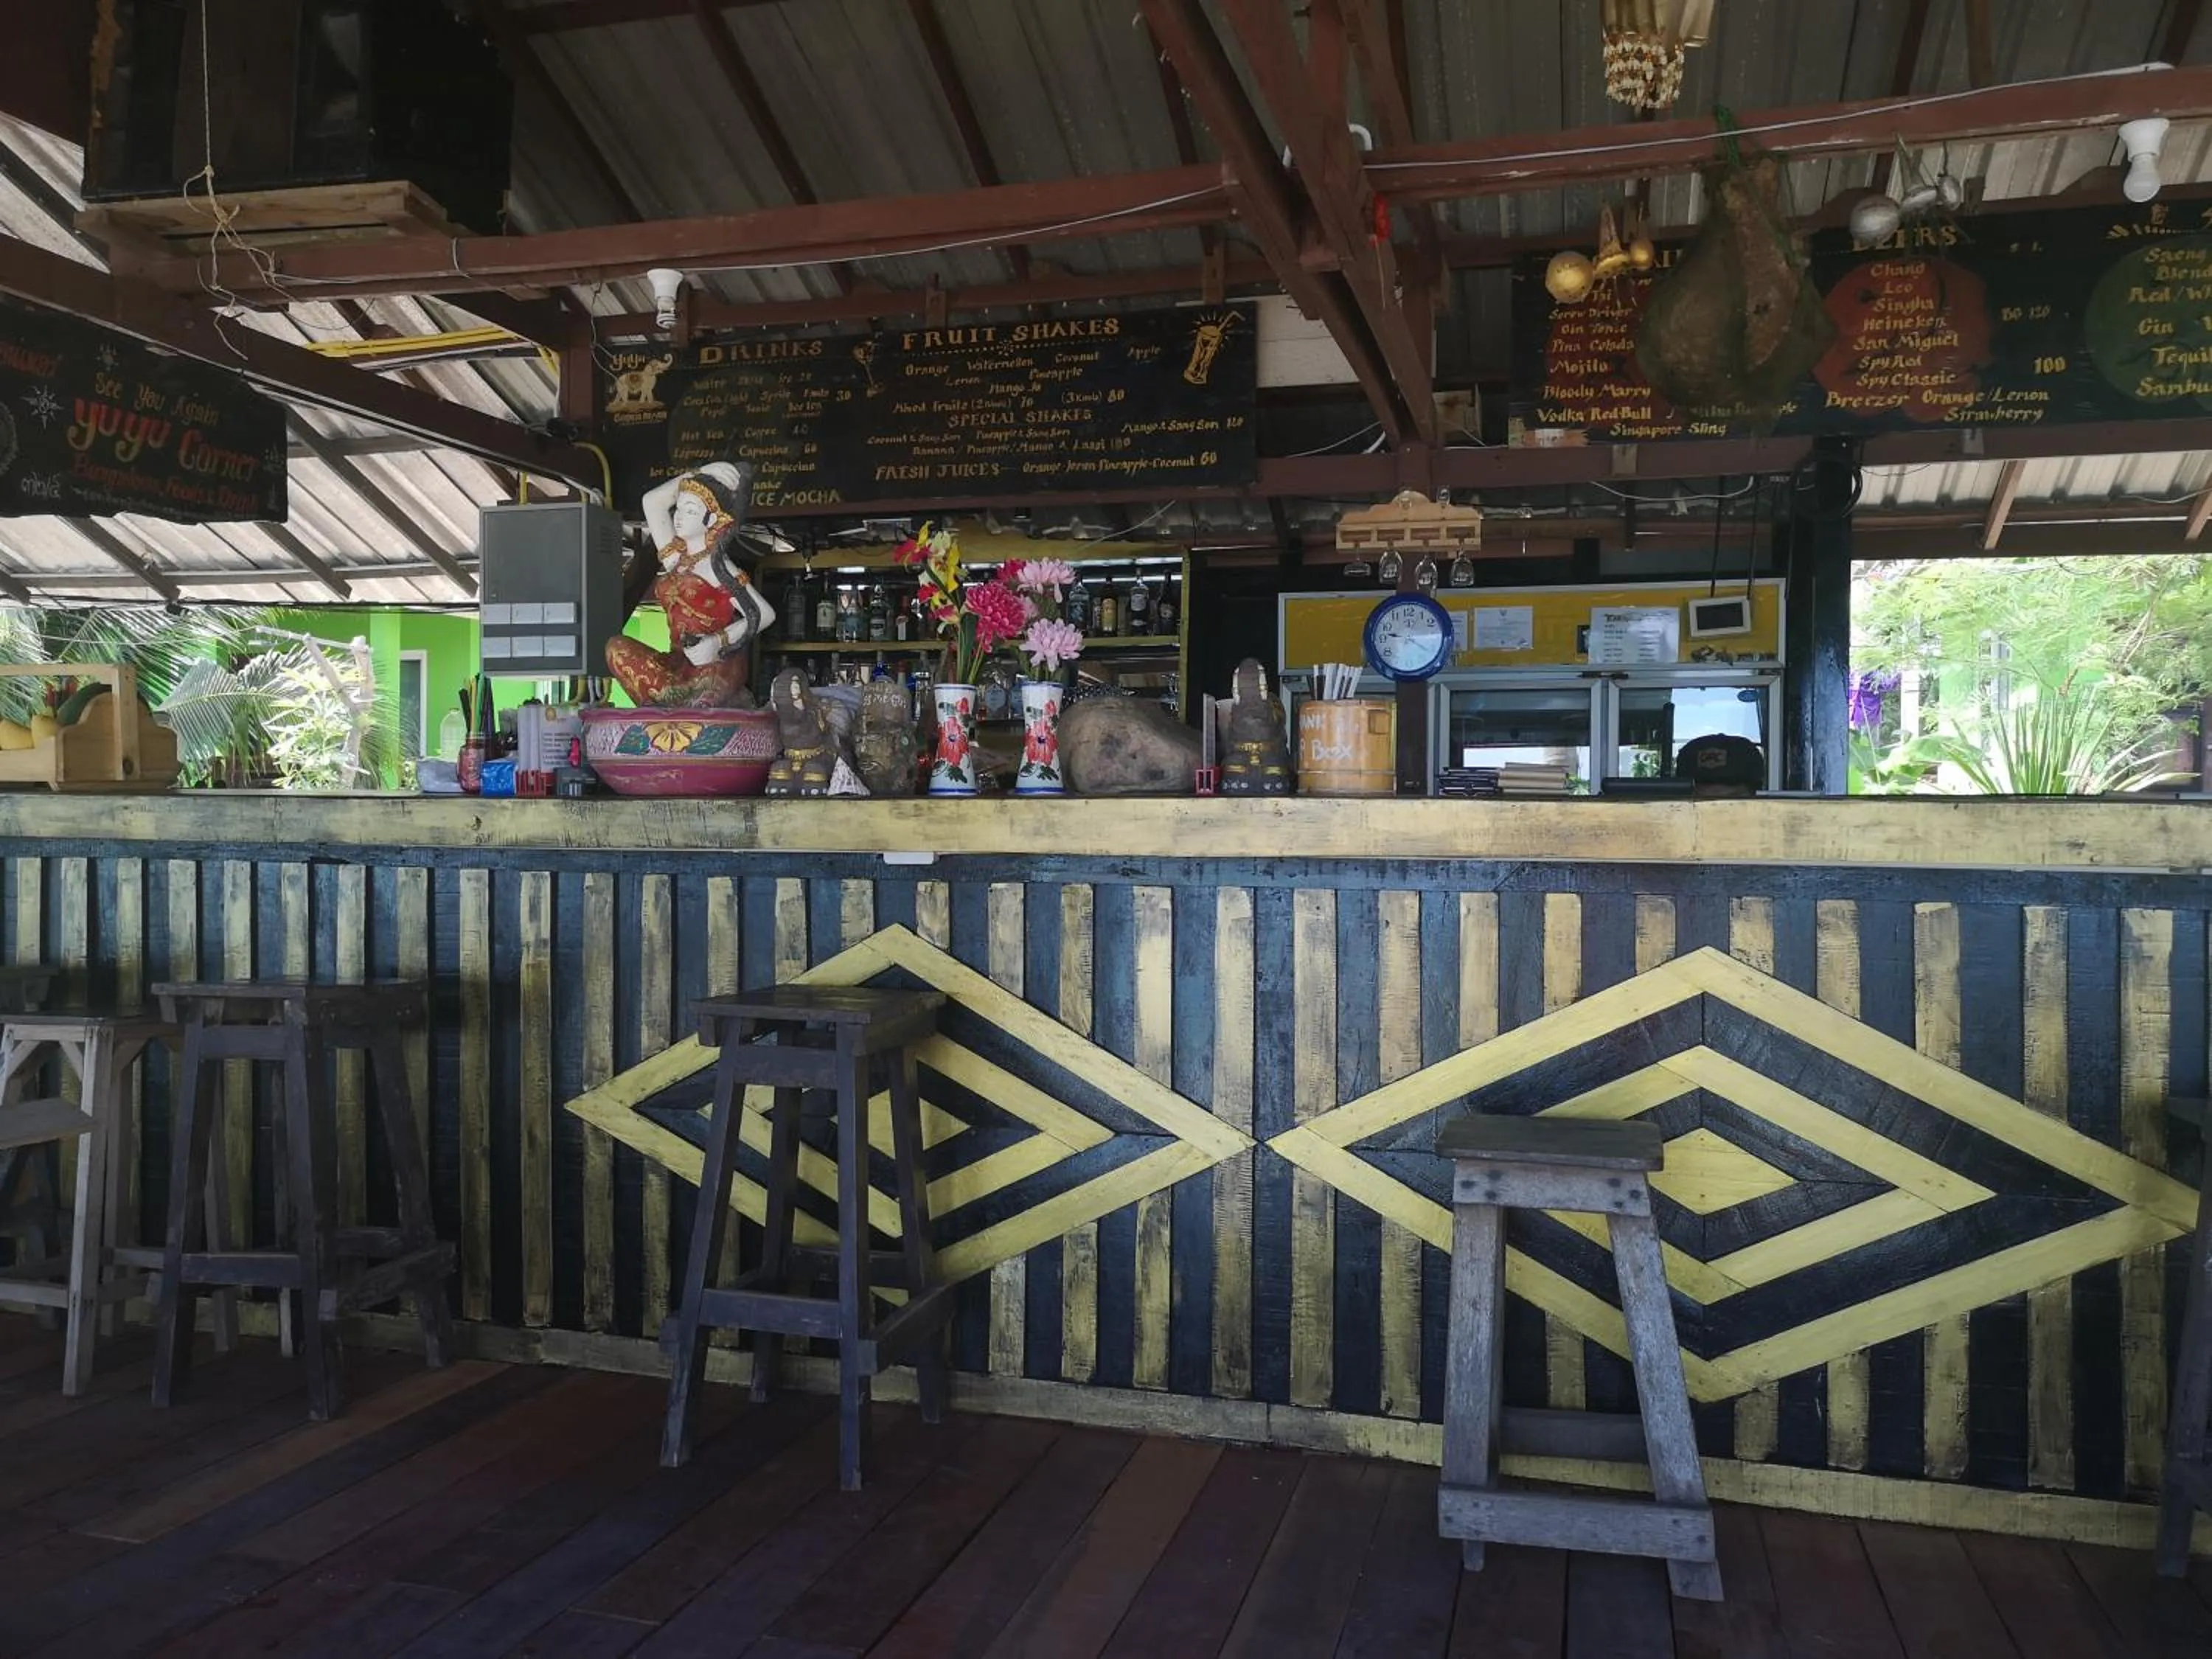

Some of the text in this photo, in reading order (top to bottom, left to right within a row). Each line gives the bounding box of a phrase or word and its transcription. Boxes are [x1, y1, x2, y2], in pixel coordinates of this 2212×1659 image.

[1870, 262, 1926, 279] Chang
[1883, 281, 1914, 293] Leo
[1873, 296, 1935, 316] Singha
[902, 318, 1120, 350] FRUIT SHAKES
[1562, 324, 1584, 335] Gin
[2139, 319, 2174, 335] Gin
[1852, 333, 1959, 352] San Miguel
[699, 342, 822, 364] DRINKS
[905, 364, 950, 377] Orange
[1056, 351, 1099, 364] Coconut
[1127, 344, 1161, 361] Apple
[1550, 358, 1608, 375] Mojito
[1858, 355, 1889, 371] Spy
[2034, 357, 2066, 375] 100
[1856, 369, 1958, 389] Spy Classic
[836, 391, 852, 402] 30
[1544, 385, 1594, 400] Bloody
[1825, 392, 1910, 408] Breezer
[1921, 390, 1985, 406] Orange
[948, 409, 1092, 428] SPECIAL SHAKES
[1537, 406, 1585, 422] Vodka
[1944, 406, 2044, 425] Strawberry
[1610, 422, 1728, 438] Singapore Sling
[914, 445, 956, 456] Banana
[876, 465, 930, 481] FRESH
[938, 462, 1001, 479] JUICES
[751, 488, 841, 507] ICE MOCHA
[1404, 608, 1414, 617] 12
[1382, 621, 1393, 632] 10
[1427, 618, 1436, 627] 2
